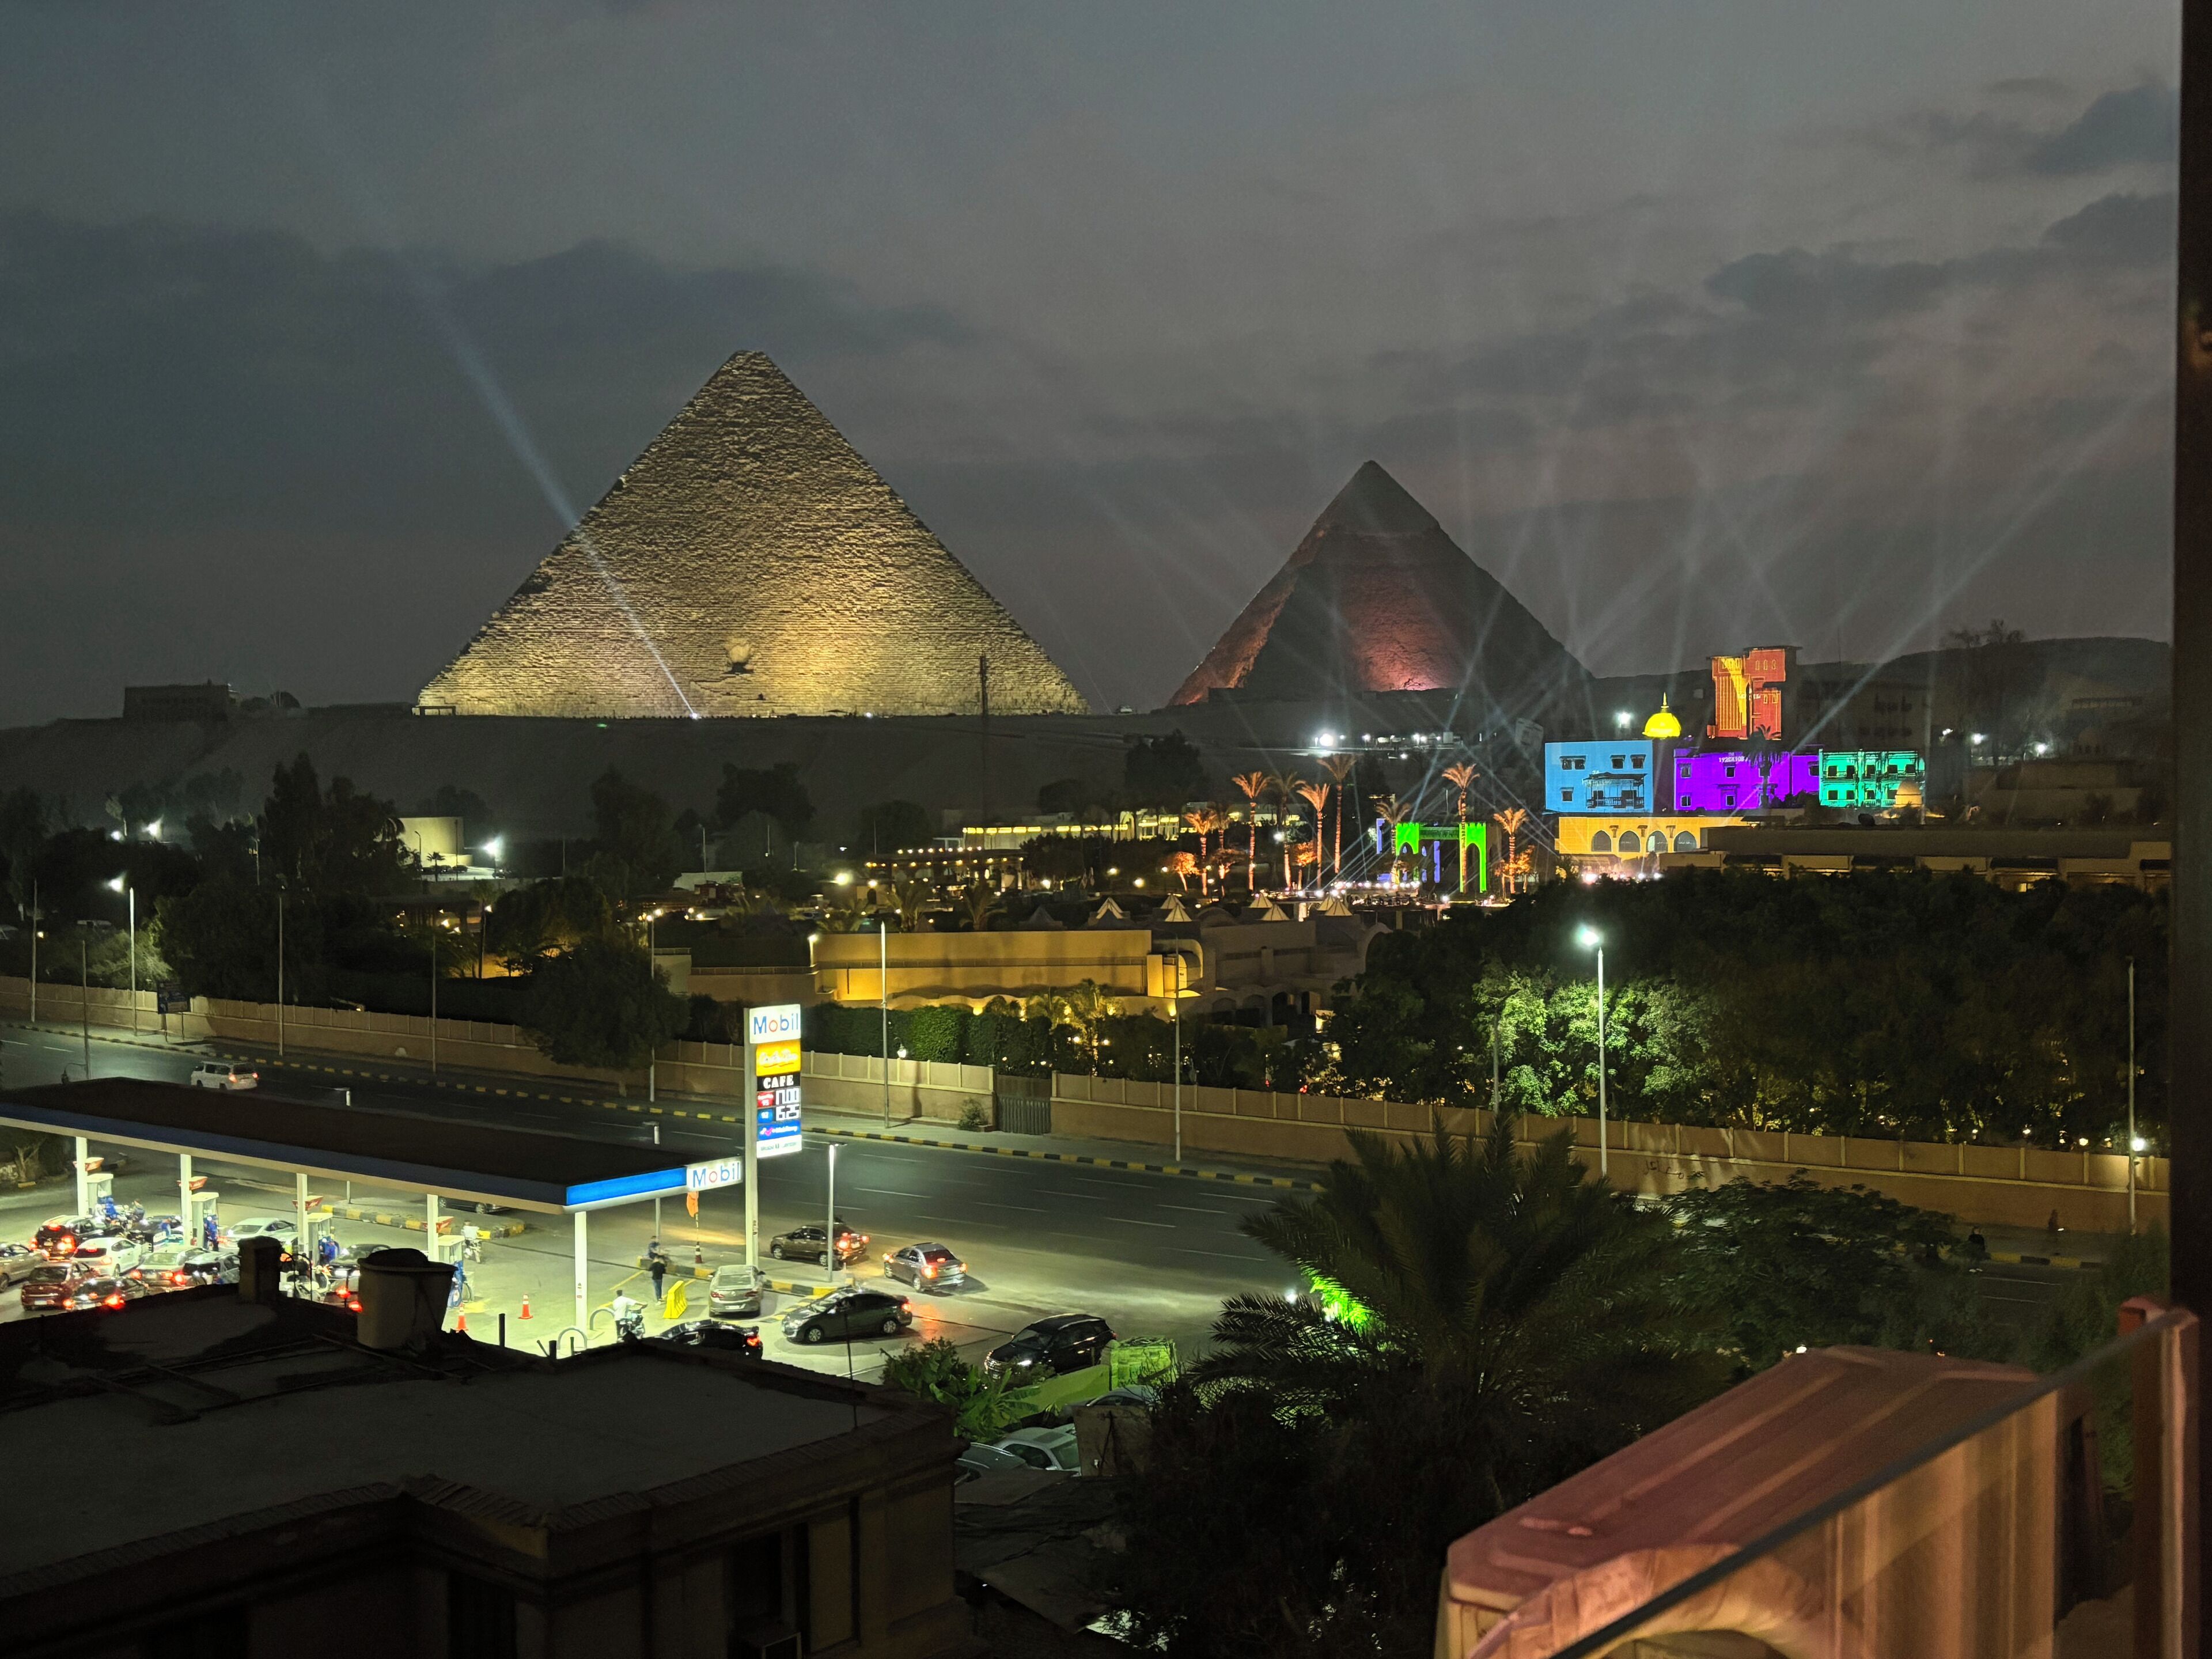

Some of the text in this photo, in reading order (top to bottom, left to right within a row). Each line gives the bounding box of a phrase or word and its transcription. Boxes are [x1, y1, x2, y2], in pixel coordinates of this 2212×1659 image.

[753, 1013, 798, 1035] Mobil
[763, 1075, 794, 1089] CAFE
[693, 1162, 740, 1188] Mobil
